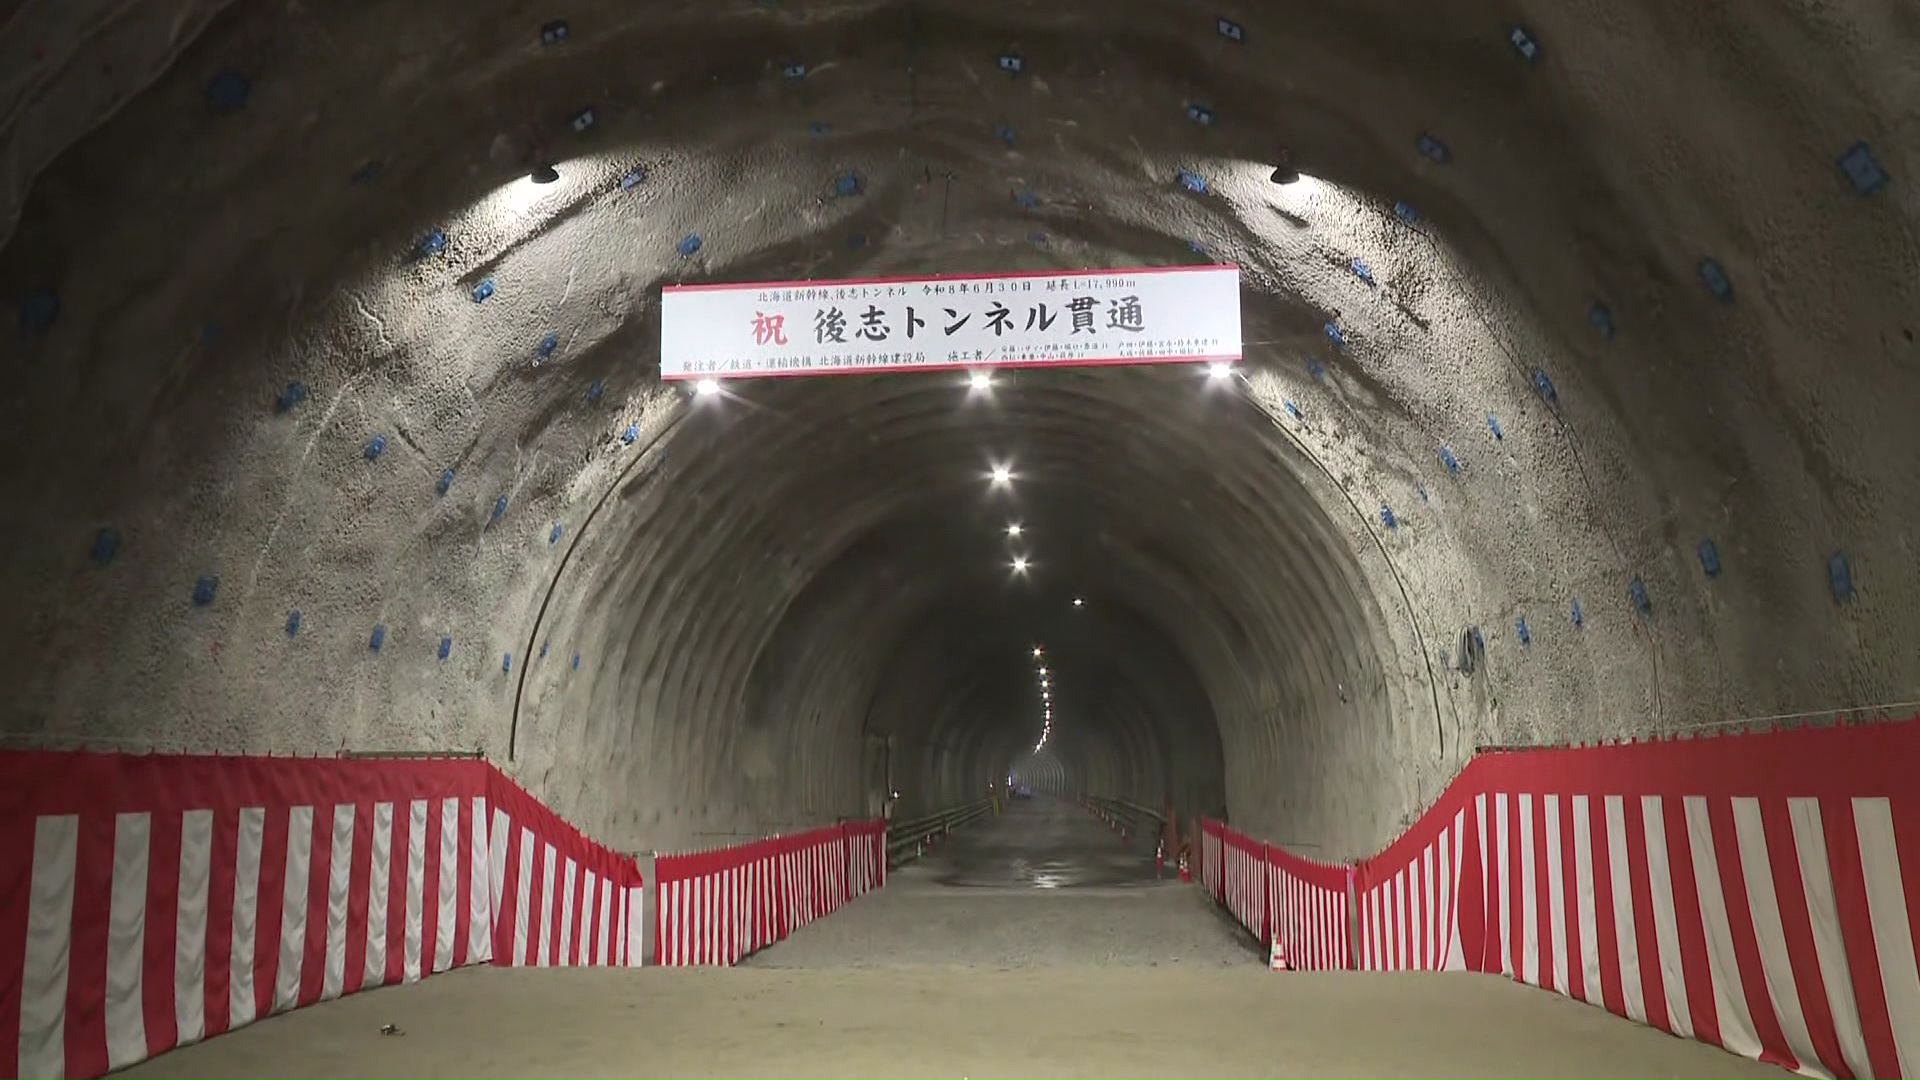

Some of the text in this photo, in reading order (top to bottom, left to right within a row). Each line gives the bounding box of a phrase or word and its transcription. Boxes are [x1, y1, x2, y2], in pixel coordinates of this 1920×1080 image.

[750, 295, 1145, 346] 祝 後志トンネル貫通
